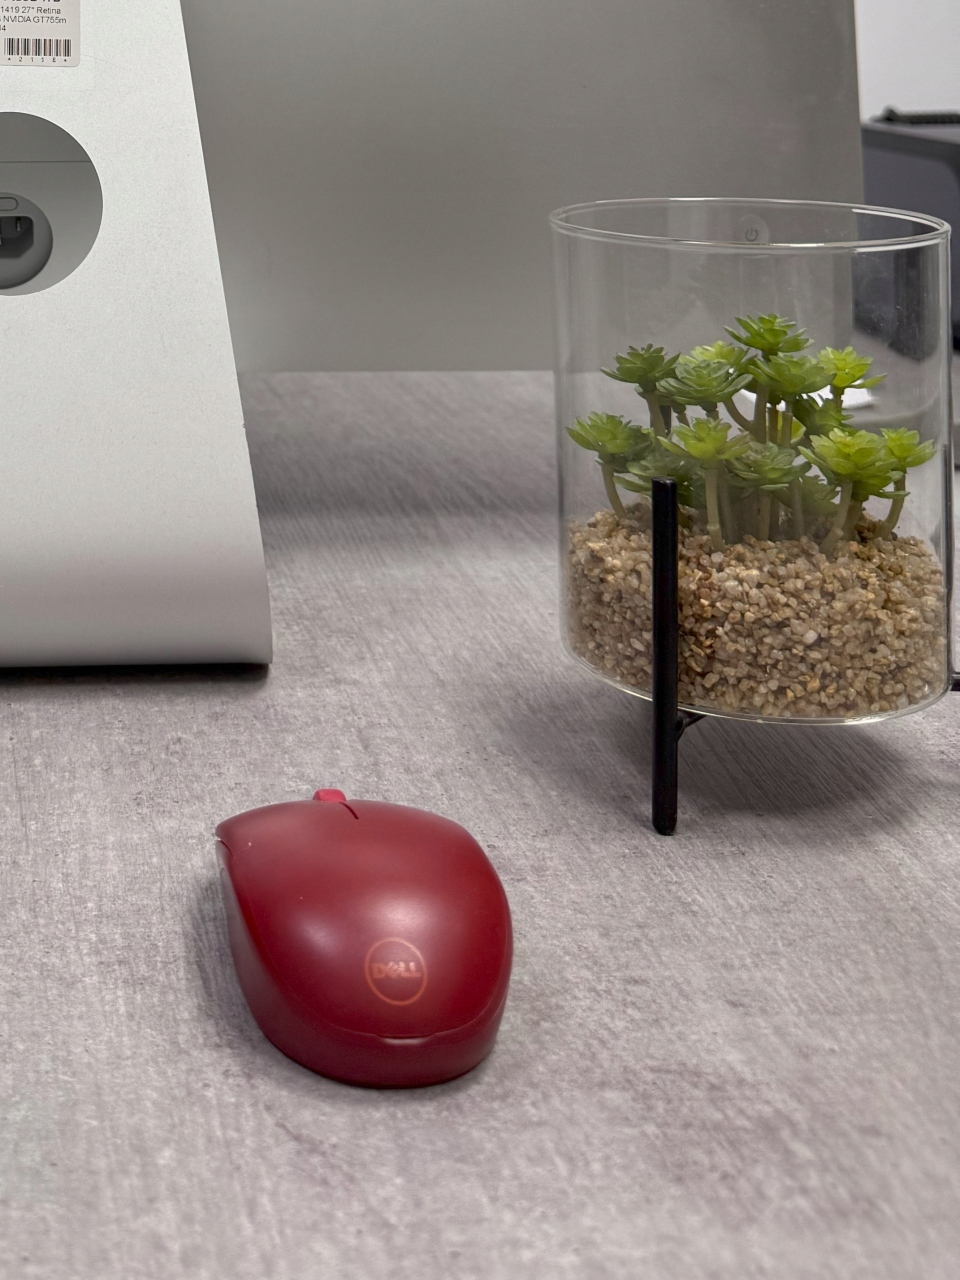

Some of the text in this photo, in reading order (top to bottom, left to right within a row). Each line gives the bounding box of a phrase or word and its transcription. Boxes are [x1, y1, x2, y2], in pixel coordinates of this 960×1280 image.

[36, 6, 62, 15] Retina
[3, 15, 32, 23] NVIDIA
[371, 961, 422, 979] DELL
